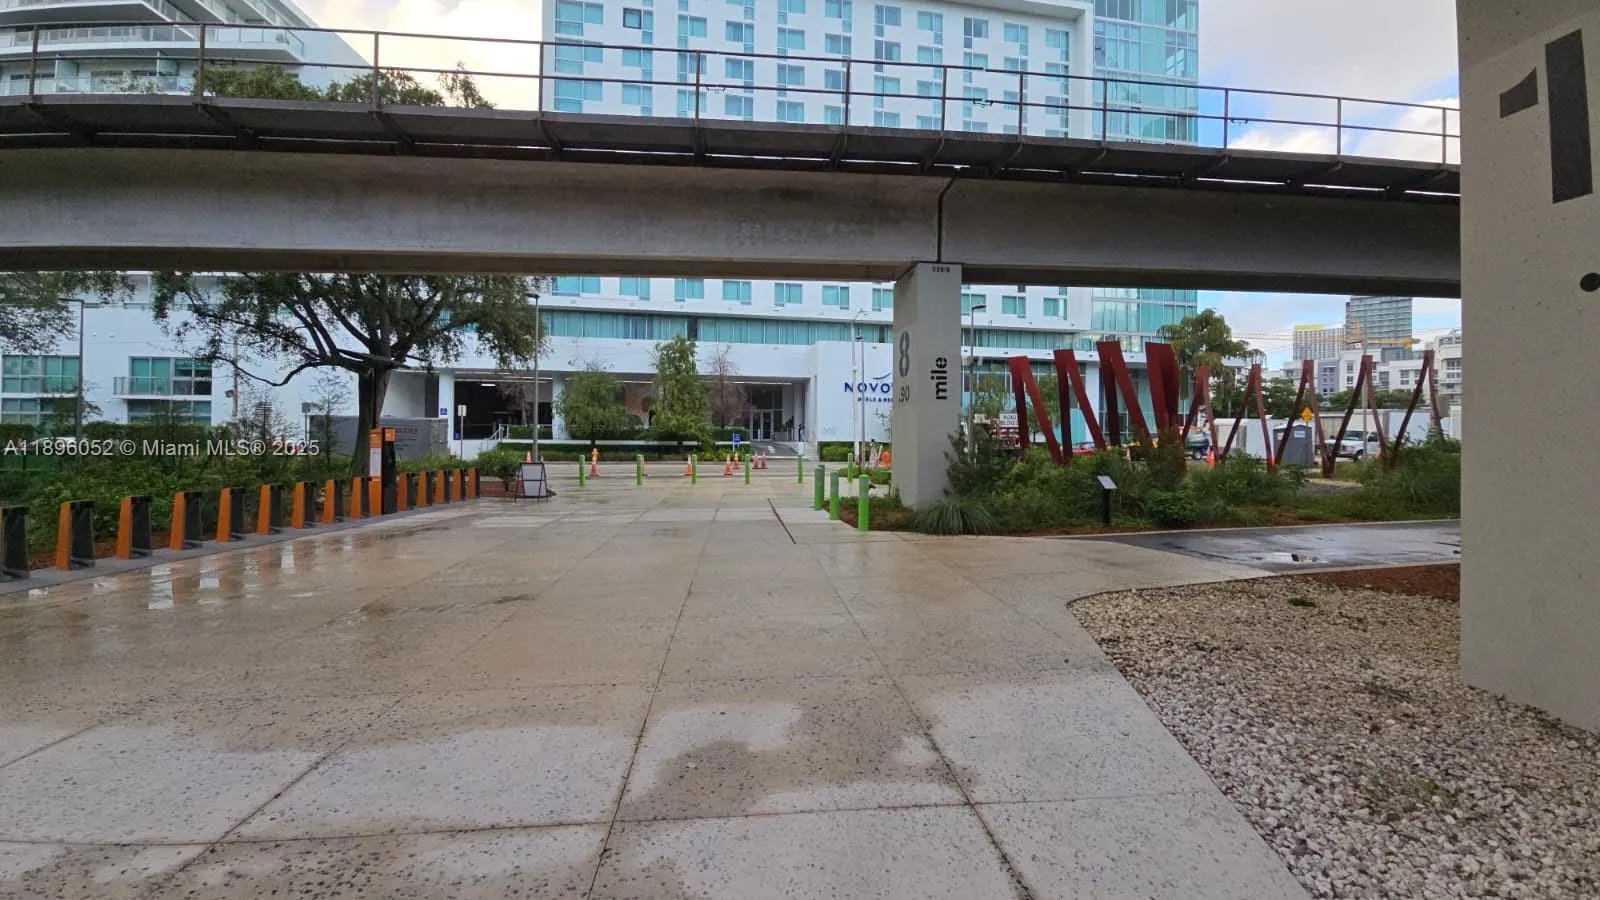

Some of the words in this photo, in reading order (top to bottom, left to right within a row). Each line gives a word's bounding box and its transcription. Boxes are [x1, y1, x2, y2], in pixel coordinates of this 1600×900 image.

[1499, 29, 1593, 204] 1
[899, 331, 910, 377] 8
[930, 356, 948, 400] mile
